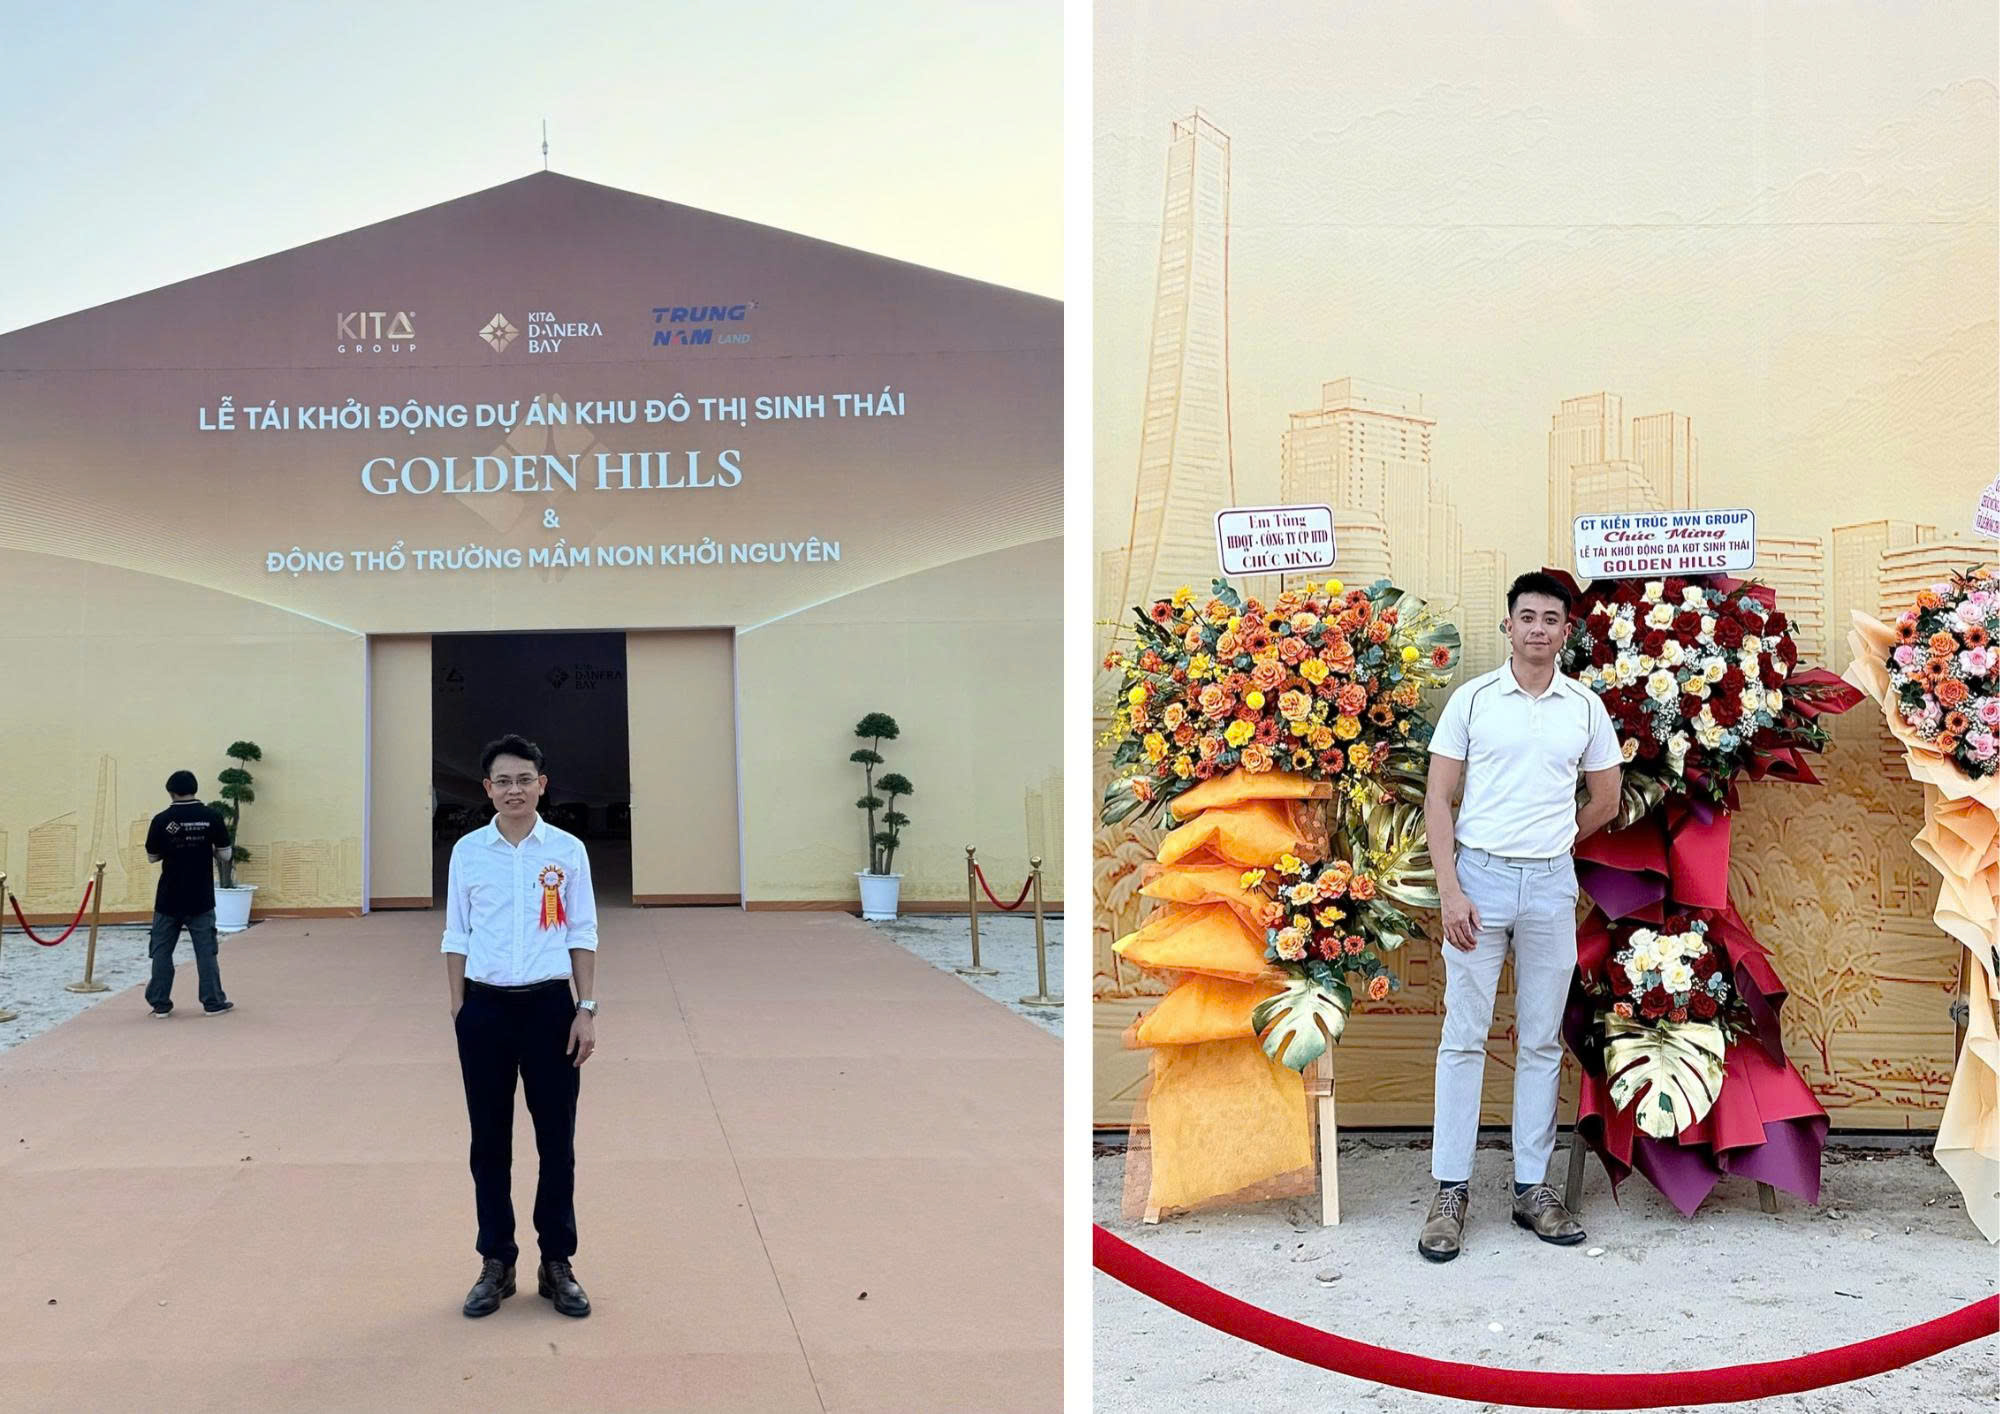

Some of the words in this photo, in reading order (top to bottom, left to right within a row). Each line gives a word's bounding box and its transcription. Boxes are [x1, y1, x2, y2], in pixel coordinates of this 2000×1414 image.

[652, 304, 746, 323] TRUNG
[528, 323, 603, 338] DANERA
[653, 329, 713, 346] NAM
[718, 334, 750, 344] LAND
[337, 344, 417, 353] GROUP
[528, 339, 561, 353] BAY
[199, 395, 236, 430] LỄ
[243, 400, 289, 429] TÁI
[299, 398, 371, 429] KHỞI
[378, 400, 468, 435] ĐỘNG
[475, 399, 520, 433] DỰ
[525, 395, 567, 426] ÁN
[575, 400, 637, 425] KHU
[644, 393, 690, 423] ĐÔ
[698, 397, 747, 427] THỊ
[755, 394, 825, 420] SINH
[832, 385, 906, 417] THÁI
[361, 454, 581, 495] GOLDEN
[594, 449, 744, 491] HILLS
[542, 508, 560, 528] &
[1274, 513, 1306, 527] Tùng
[1581, 519, 1596, 531] CT
[1634, 515, 1668, 529] TRÚC
[1672, 515, 1701, 527] MVN
[1705, 513, 1748, 525] GROUP
[1286, 532, 1297, 545] TY
[1298, 531, 1310, 544] CP
[1603, 530, 1656, 543] Chúc
[1703, 541, 1726, 552] SINH
[266, 546, 344, 577] ĐỘNG
[351, 540, 405, 571] THỔ
[412, 543, 522, 570] TRƯỜNG
[528, 538, 591, 568] MẦM
[597, 544, 654, 567] NON
[660, 536, 723, 566] KHỞI
[731, 536, 841, 564] NGUYÊN
[1603, 558, 1672, 573] GOLDEN
[1679, 555, 1727, 569] HILLS
